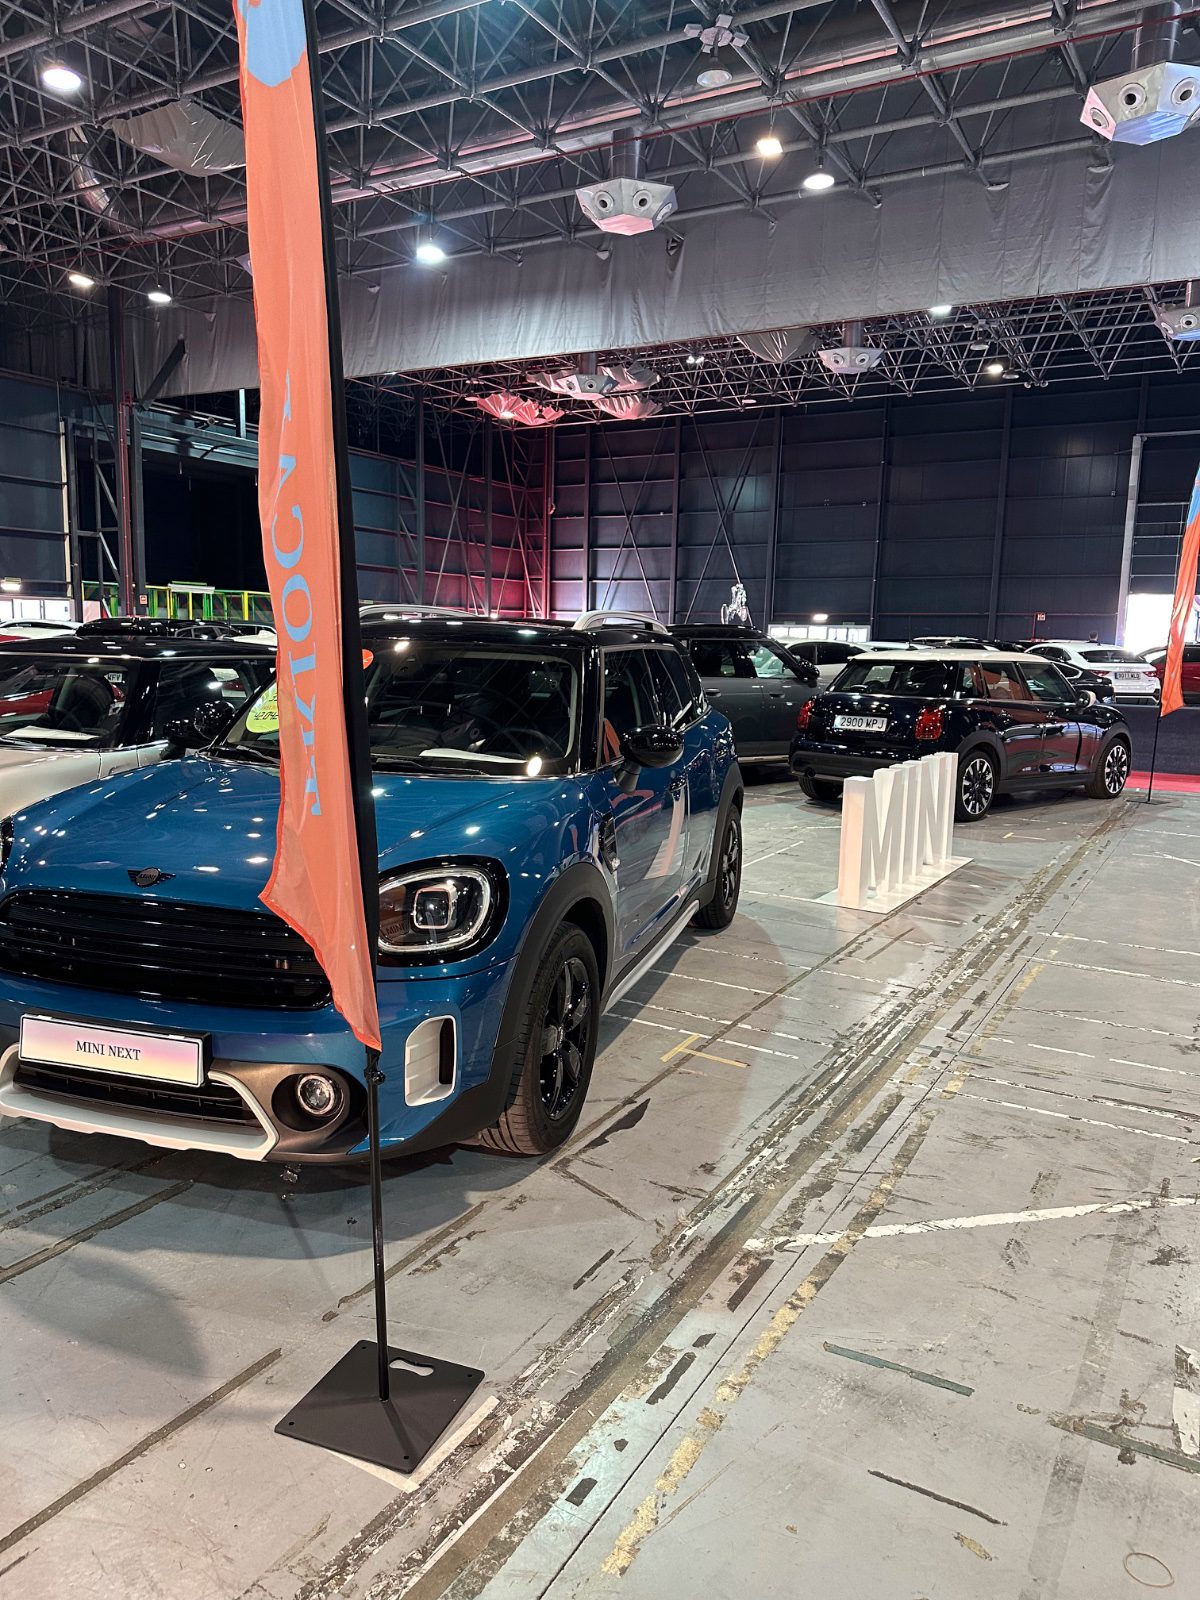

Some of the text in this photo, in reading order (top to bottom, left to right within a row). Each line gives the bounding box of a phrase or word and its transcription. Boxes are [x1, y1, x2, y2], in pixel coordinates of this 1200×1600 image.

[840, 717, 885, 729] 2900 MPJ
[838, 751, 959, 908] MINI
[75, 1040, 141, 1061] MINI NEXT
